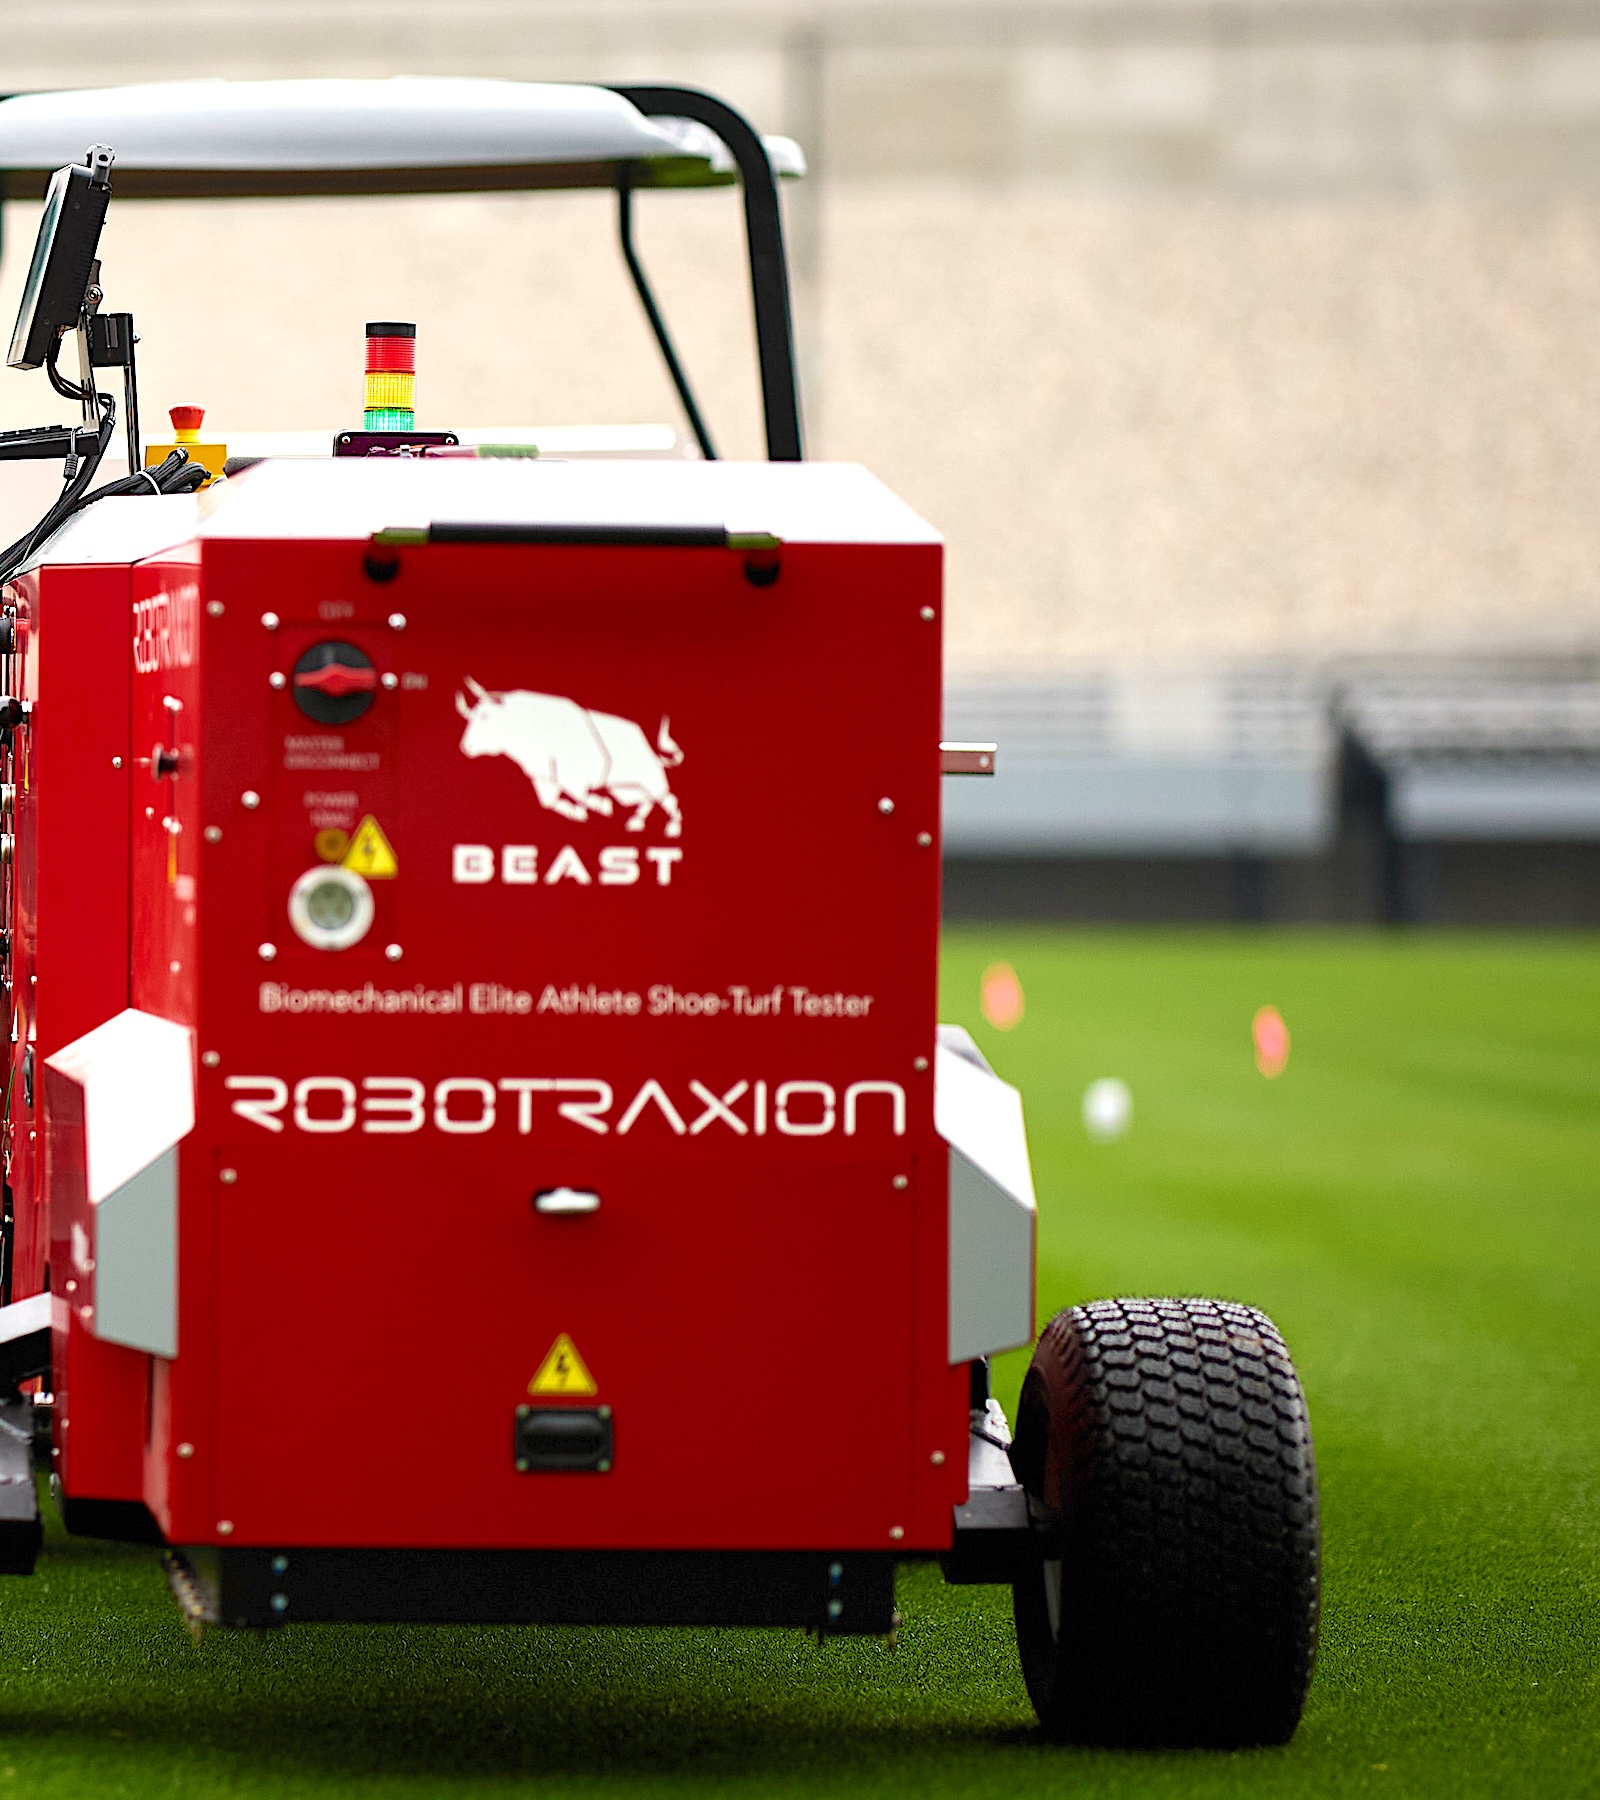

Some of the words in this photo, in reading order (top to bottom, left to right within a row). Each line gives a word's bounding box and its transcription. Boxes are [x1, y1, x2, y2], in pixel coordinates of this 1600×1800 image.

[452, 843, 683, 886] BEAST
[259, 981, 463, 1014] Biomechanical
[469, 982, 533, 1014] Elite
[536, 983, 642, 1015] Athlete
[648, 984, 784, 1016] Shoe-Turf
[788, 986, 874, 1017] Tester
[224, 1076, 906, 1136] ROBOTRAXION
